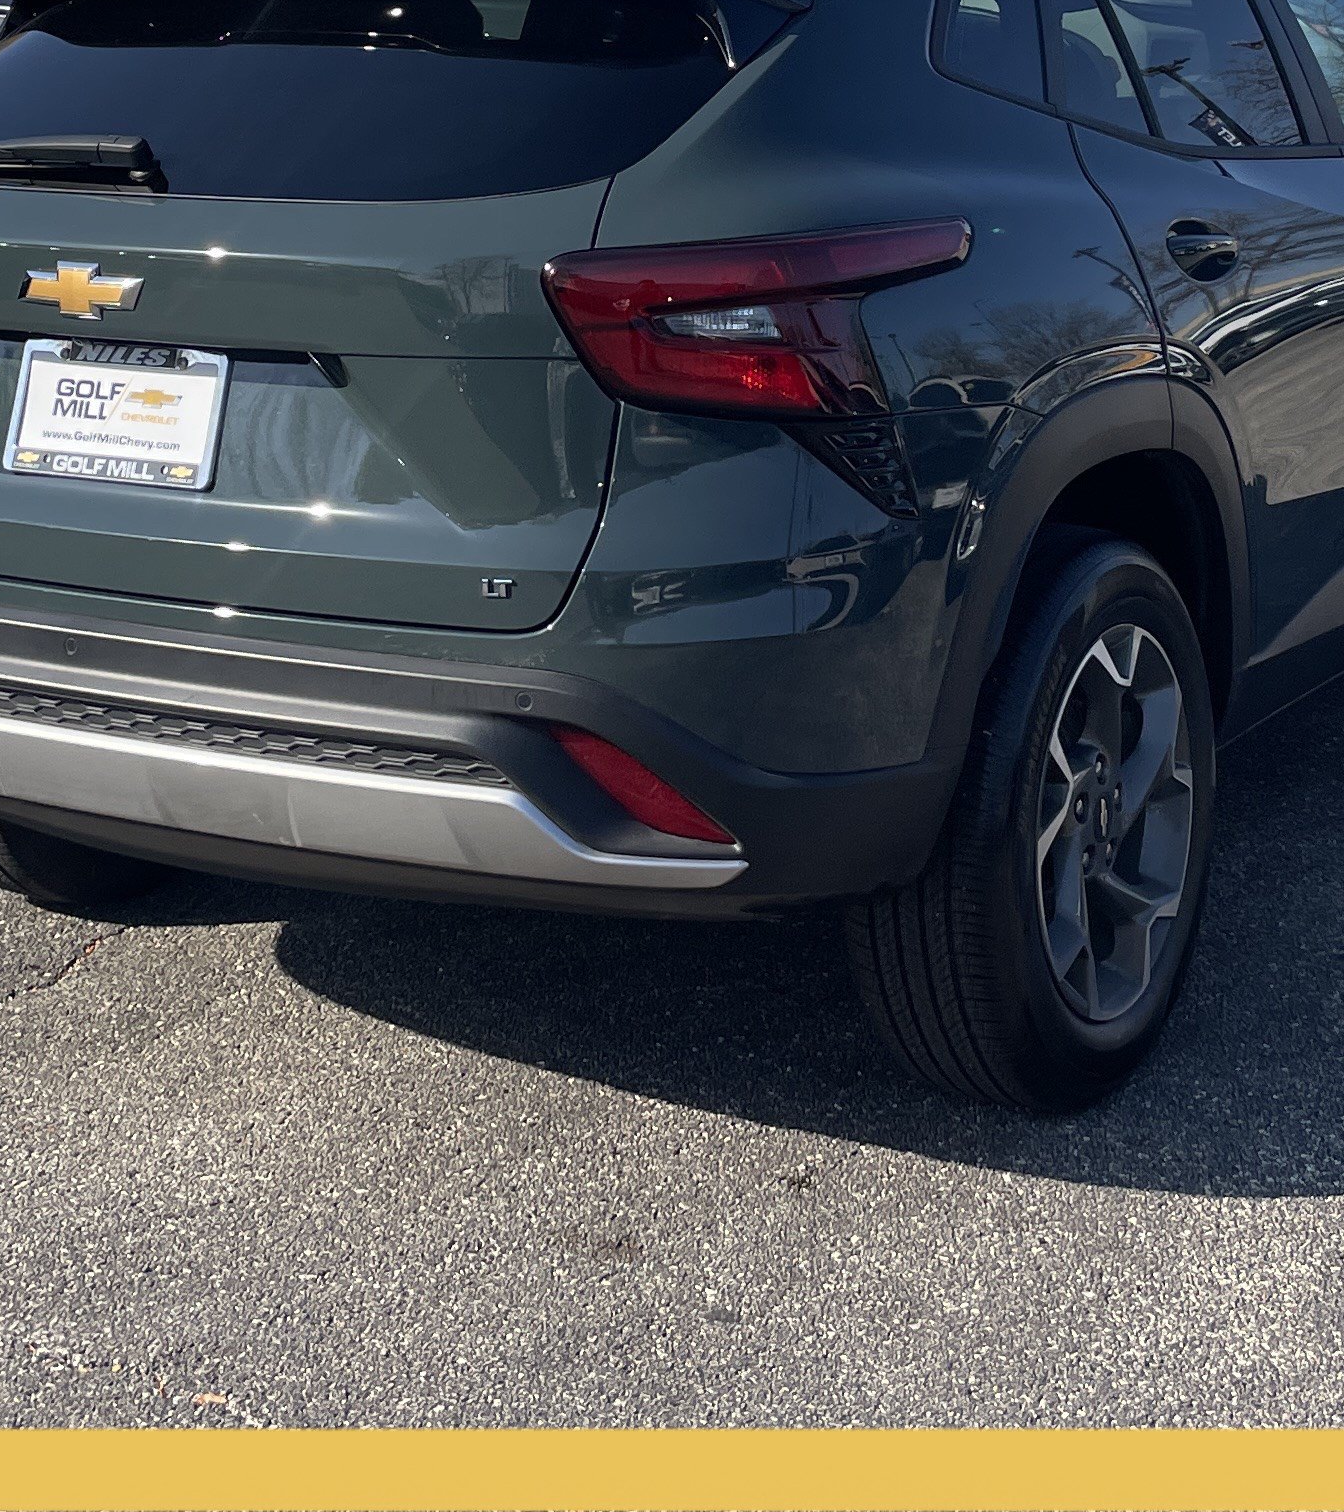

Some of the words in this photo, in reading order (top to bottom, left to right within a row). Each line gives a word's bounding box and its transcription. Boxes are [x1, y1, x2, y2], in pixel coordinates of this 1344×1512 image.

[78, 343, 171, 367] NILES
[57, 378, 126, 401] GOLF
[52, 398, 107, 421] MILL
[41, 430, 181, 451] www.GolfMillChevy.com
[52, 454, 106, 475] GOLF
[106, 459, 155, 481] MILL
[481, 578, 513, 598] LT
